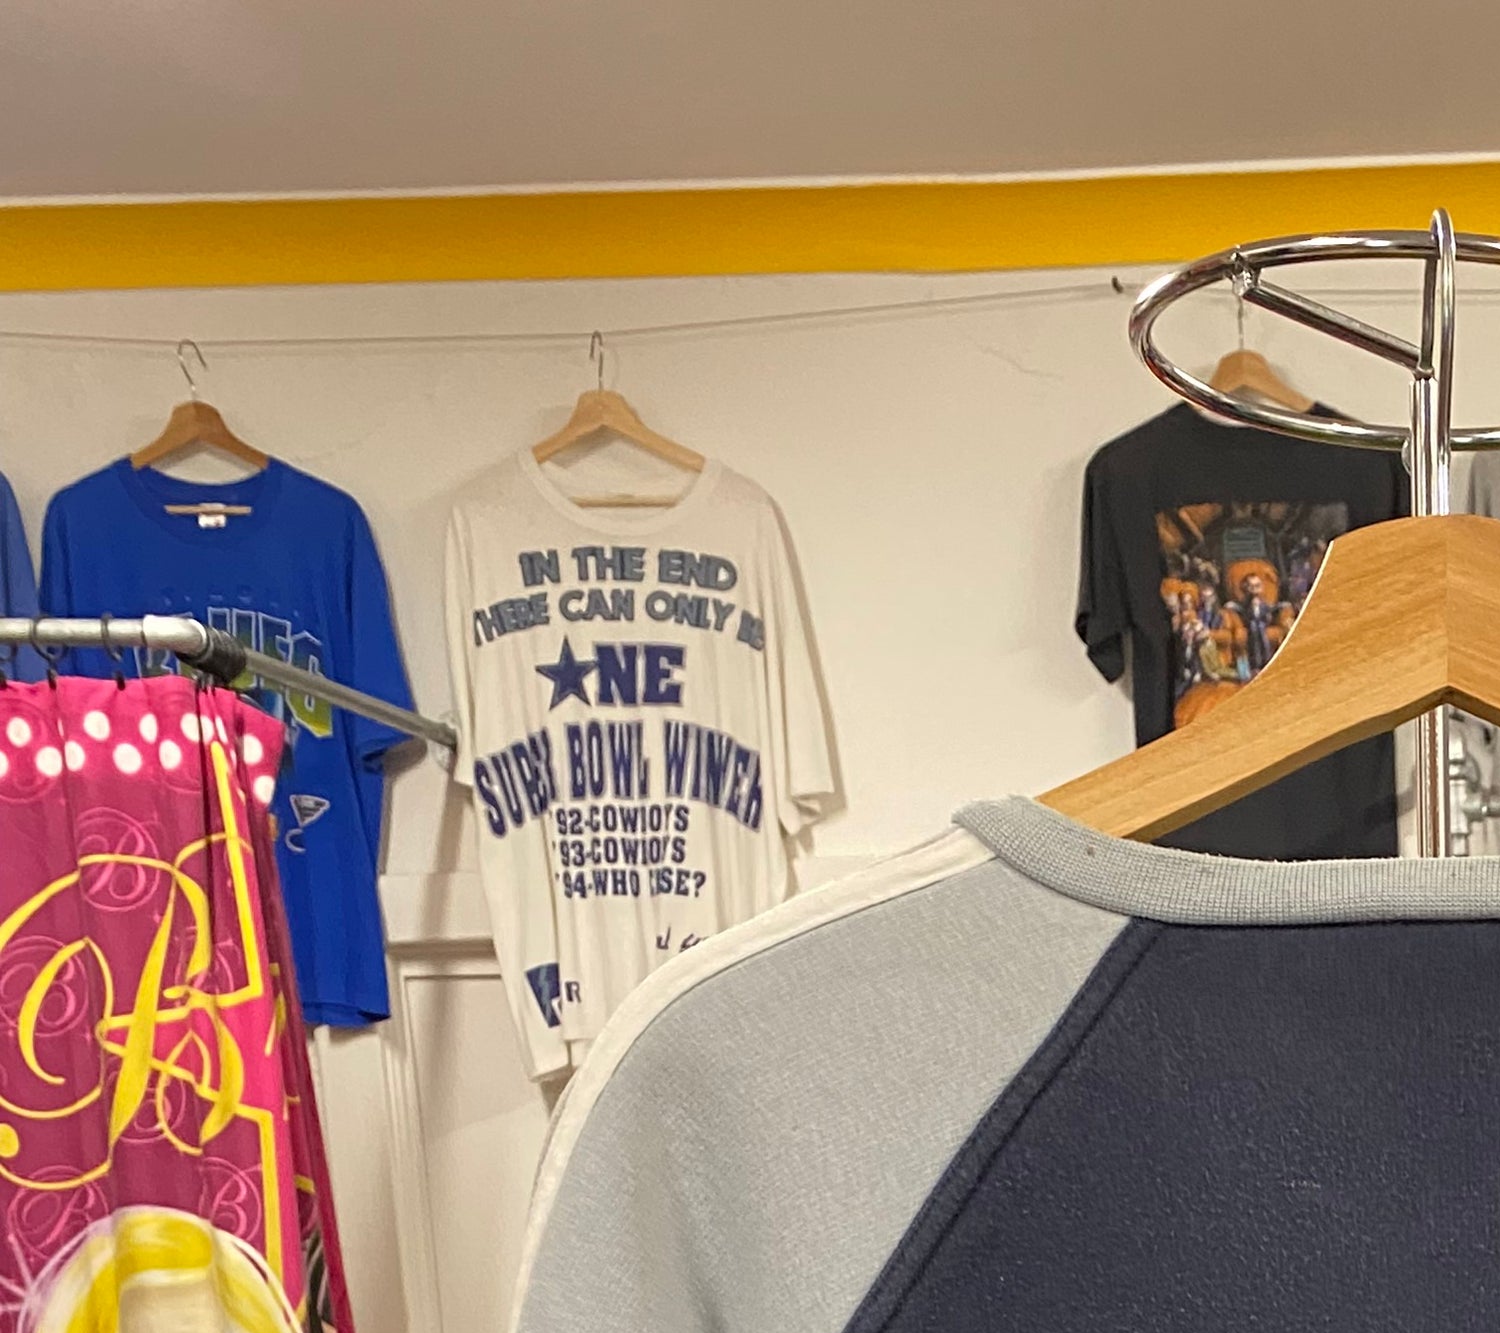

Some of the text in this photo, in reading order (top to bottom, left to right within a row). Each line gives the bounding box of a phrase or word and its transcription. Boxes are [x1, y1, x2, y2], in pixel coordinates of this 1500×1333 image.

[518, 546, 738, 592] IN THE END
[558, 588, 635, 621] CAN
[645, 590, 736, 632] ONLY
[564, 719, 650, 801] BOWL
